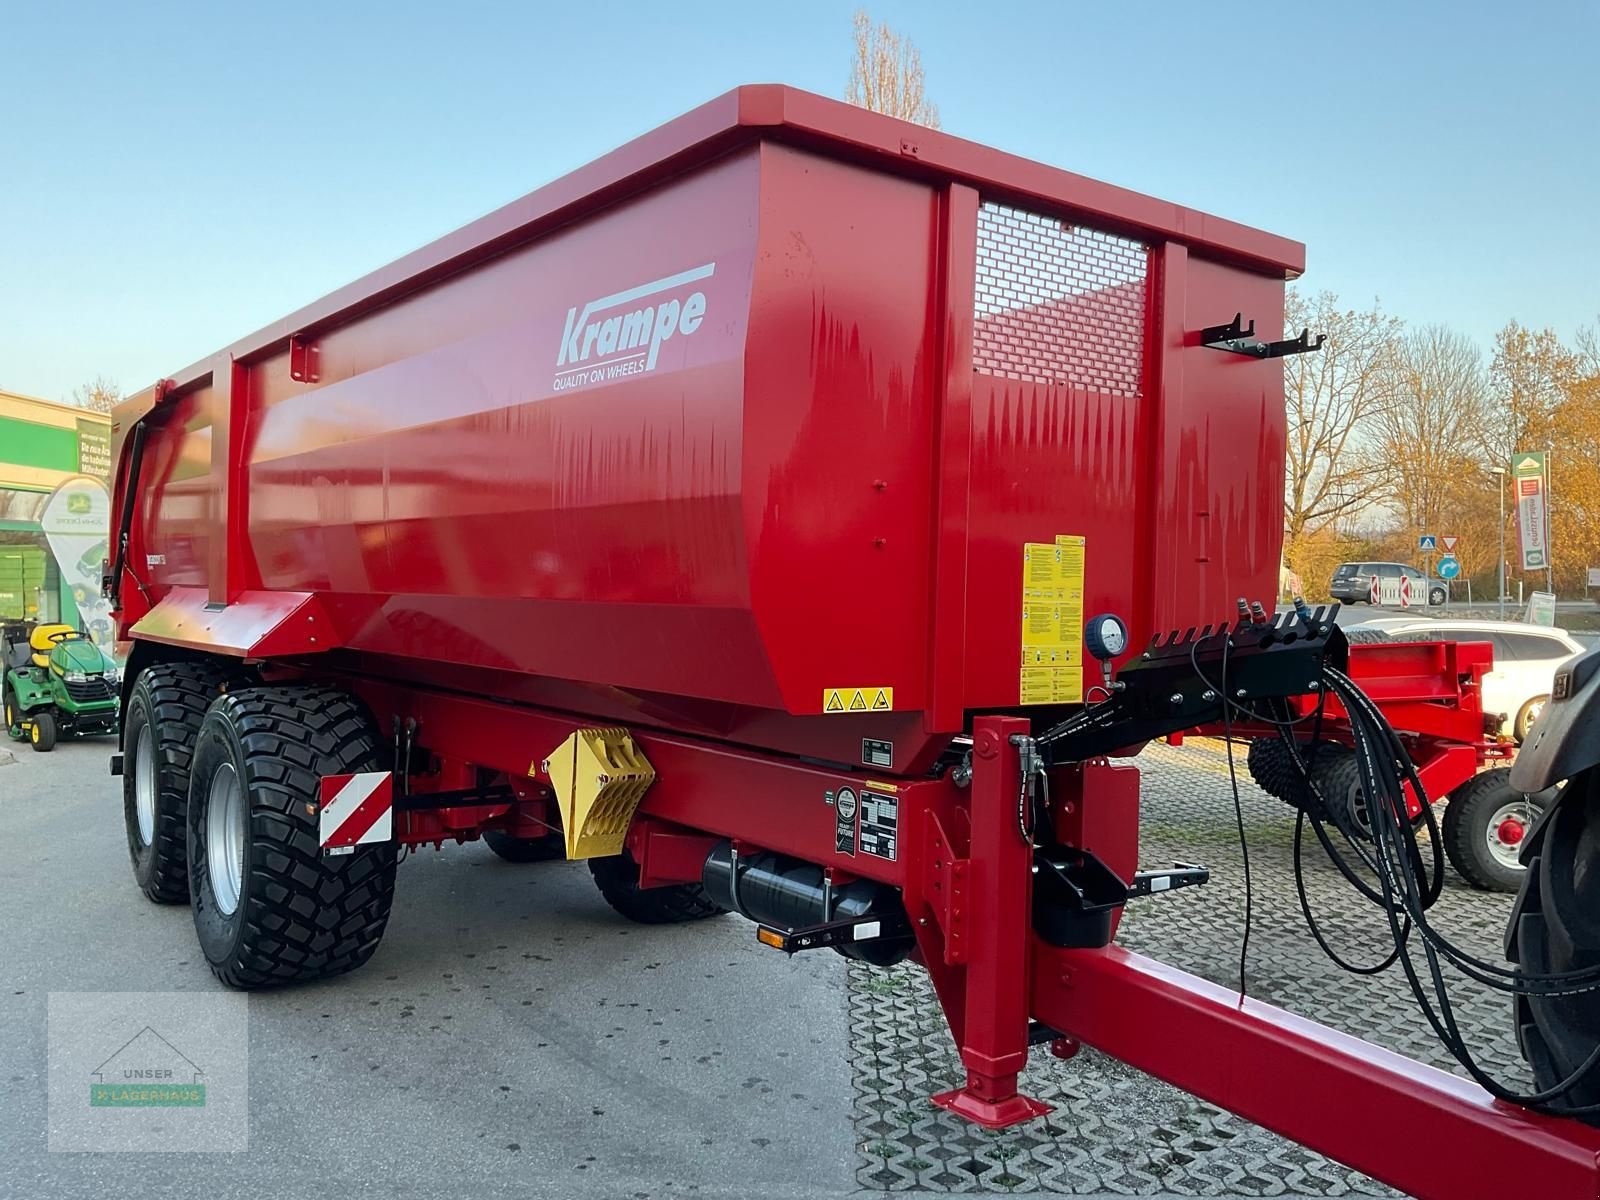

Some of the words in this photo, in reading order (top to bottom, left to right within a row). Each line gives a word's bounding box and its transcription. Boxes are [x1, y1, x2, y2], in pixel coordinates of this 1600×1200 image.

[556, 264, 715, 371] Krampe
[553, 370, 589, 391] QUALITY
[590, 367, 605, 383] ON
[607, 359, 645, 380] WHEELS
